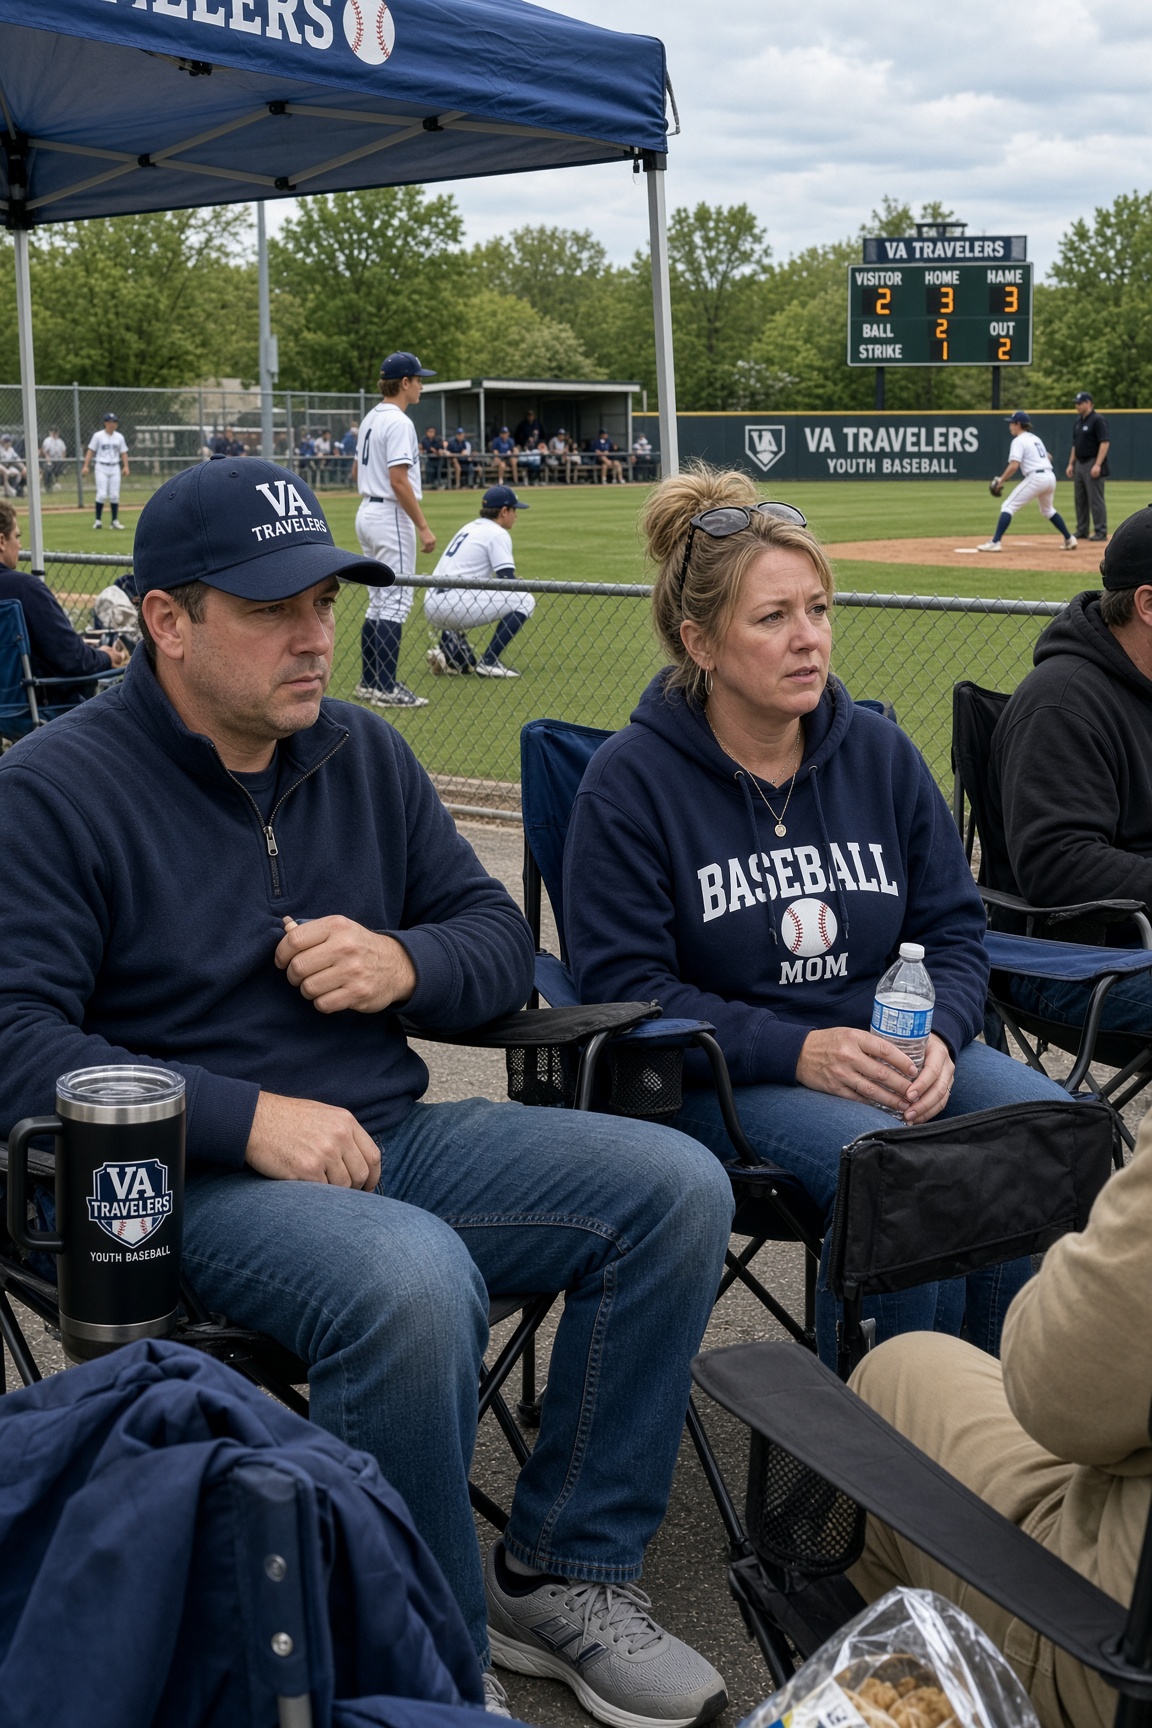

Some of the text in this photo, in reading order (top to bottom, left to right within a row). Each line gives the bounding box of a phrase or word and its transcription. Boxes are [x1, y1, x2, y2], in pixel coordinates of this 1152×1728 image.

[885, 241, 1004, 259] VA TRAVELERS
[855, 272, 902, 285] VISITOR
[925, 271, 960, 284] HOME
[987, 270, 1023, 283] HAME
[876, 288, 891, 315] 2
[940, 287, 954, 313] 3
[1004, 286, 1018, 313] 3
[862, 324, 894, 337] BALL
[936, 319, 948, 338] 2
[990, 322, 1015, 336] OUT
[859, 344, 902, 359] STRIKE
[942, 341, 948, 360] 1
[998, 338, 1011, 360] 2
[804, 427, 979, 453] VA TRAVELERS
[827, 458, 957, 473] YOUTH BASEBALL
[255, 480, 312, 517] VA
[251, 517, 327, 541] TRAVELERS
[697, 842, 899, 923] BASEBALL
[779, 952, 848, 985] MOM
[106, 1166, 155, 1199] VA
[91, 1196, 169, 1217] TRAVELERS
[90, 1245, 170, 1262] YOUTH BASEBALL
